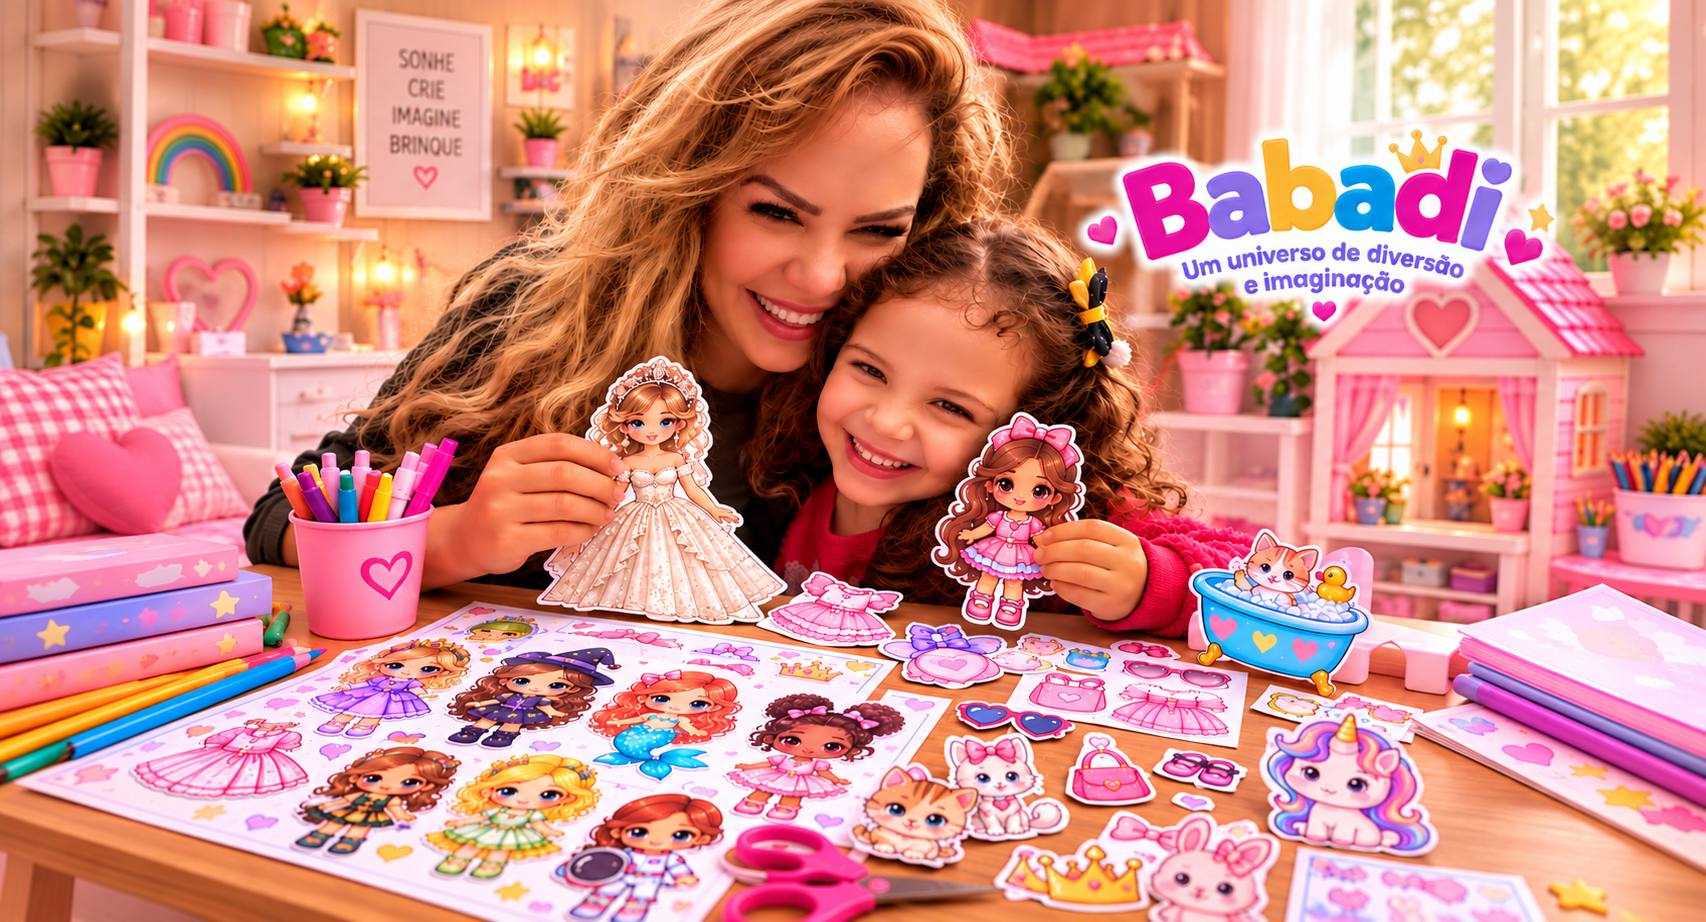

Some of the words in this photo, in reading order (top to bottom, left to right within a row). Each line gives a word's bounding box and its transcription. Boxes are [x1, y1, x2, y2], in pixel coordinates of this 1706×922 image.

[398, 49, 454, 72] SONHE
[407, 78, 445, 100] CRIE
[391, 106, 461, 128] IMAGINE
[389, 135, 462, 156] BRINQUE
